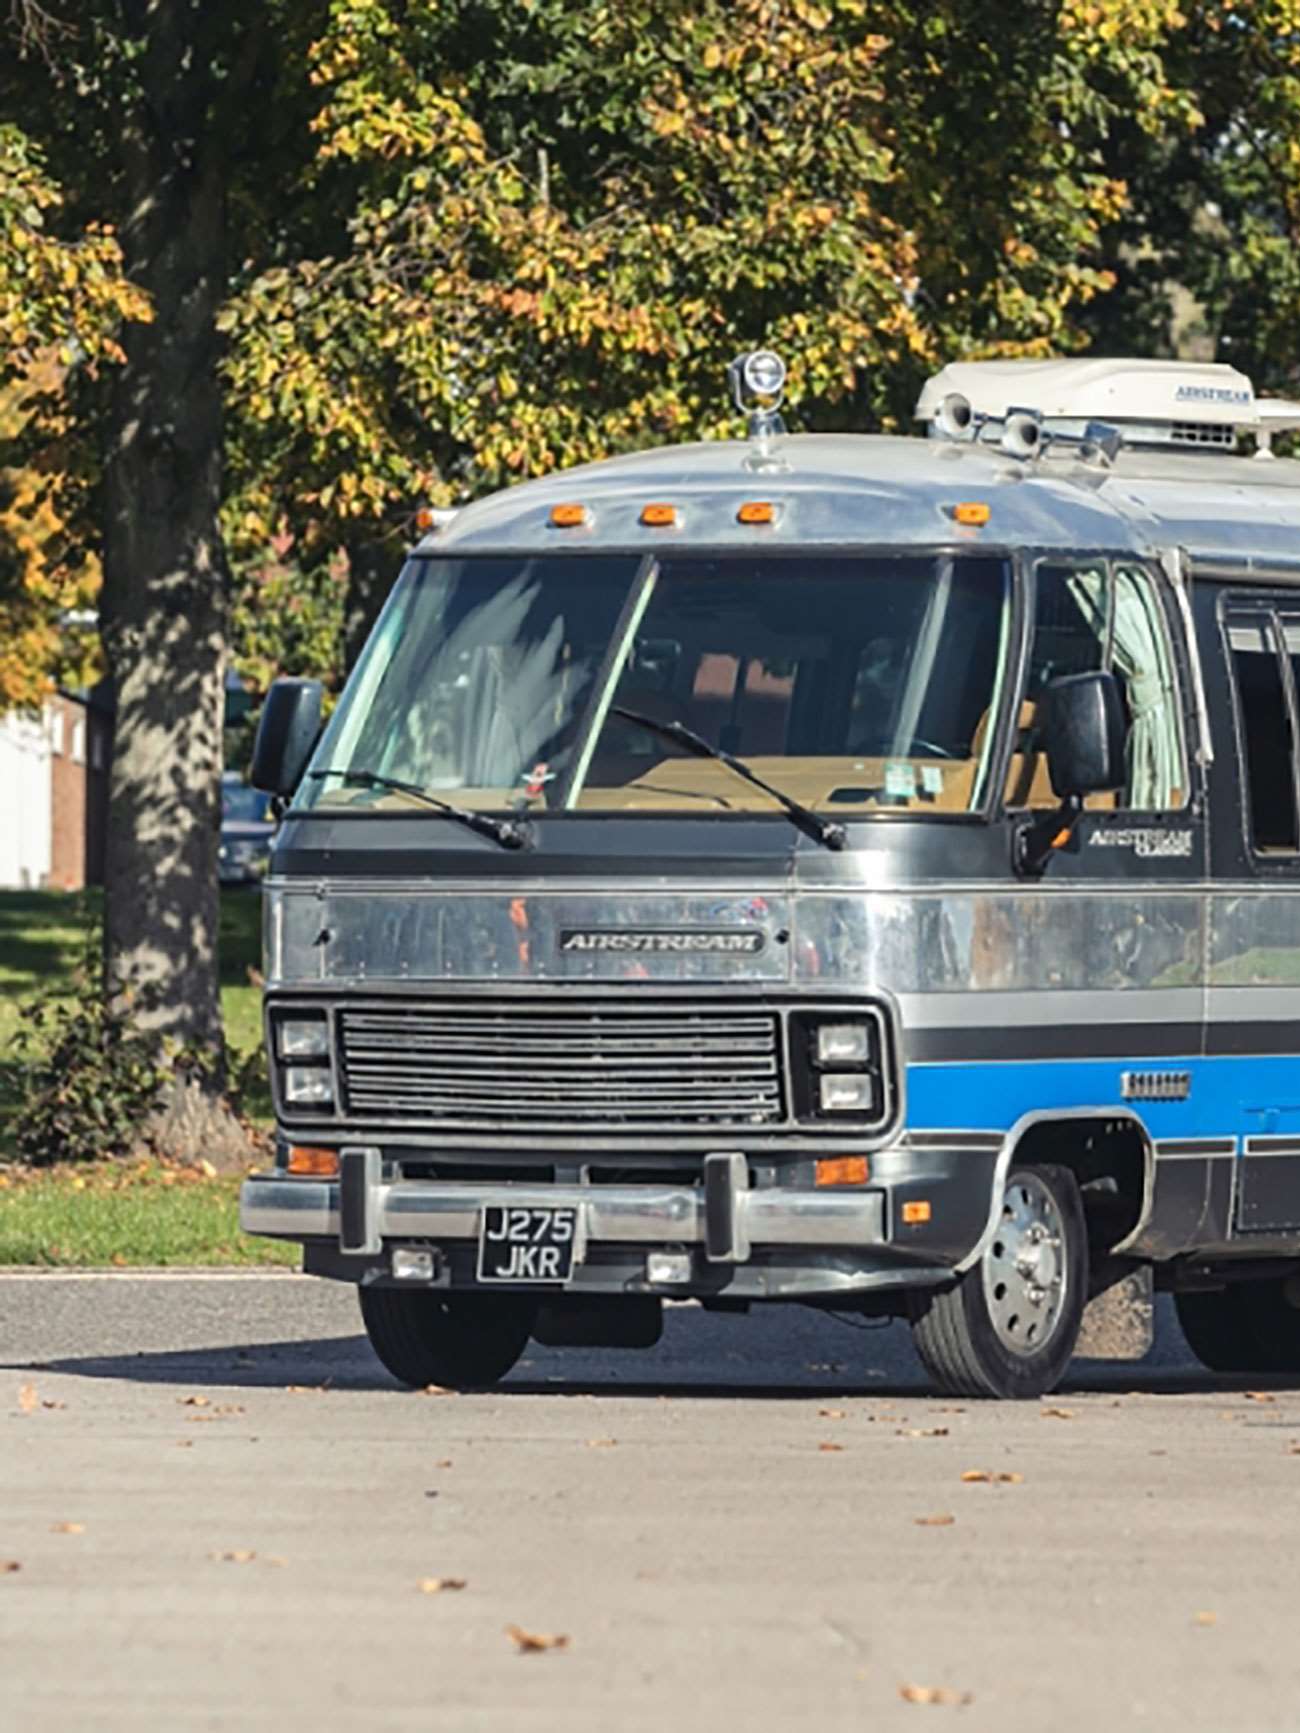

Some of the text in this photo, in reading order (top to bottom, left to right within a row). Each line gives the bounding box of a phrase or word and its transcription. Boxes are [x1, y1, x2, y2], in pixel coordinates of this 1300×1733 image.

[562, 933, 758, 950] AIRSTREAM
[487, 1208, 573, 1241] J275
[496, 1246, 561, 1276] JKR
